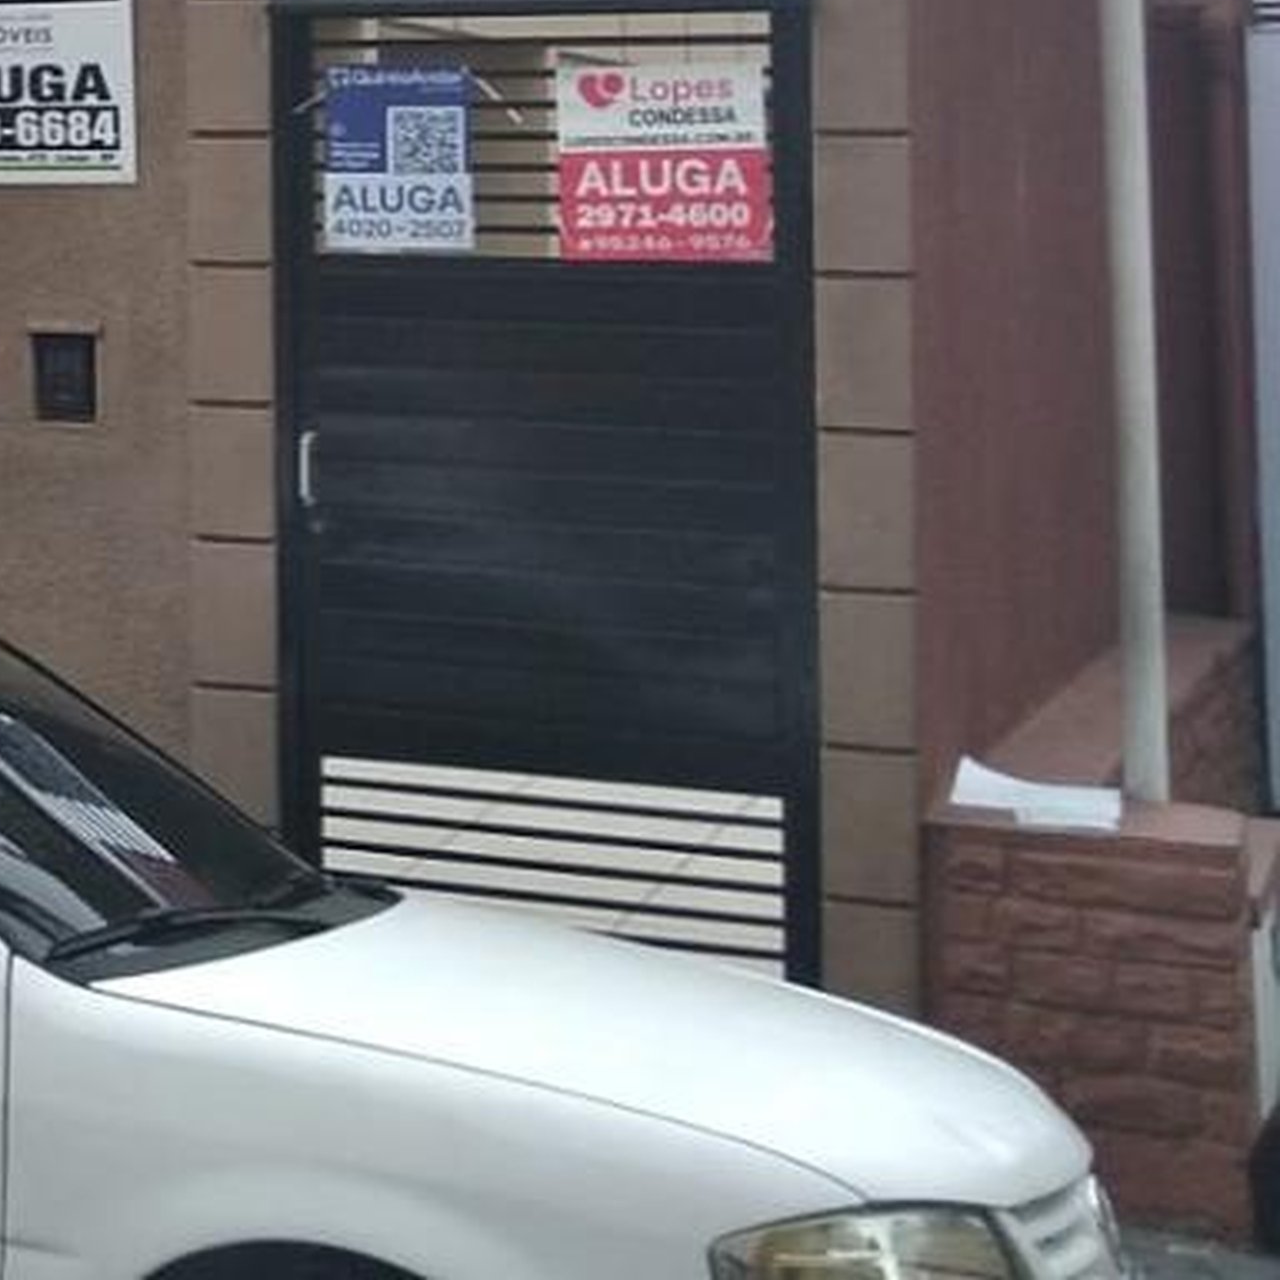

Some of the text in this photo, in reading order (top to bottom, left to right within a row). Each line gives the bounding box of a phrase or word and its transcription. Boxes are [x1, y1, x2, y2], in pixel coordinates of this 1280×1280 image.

[629, 75, 734, 104] Lopes
[628, 107, 737, 128] CONDESSA
[576, 158, 748, 197] ALUGA
[332, 184, 464, 214] ALUGA
[576, 202, 751, 228] 2971-4600
